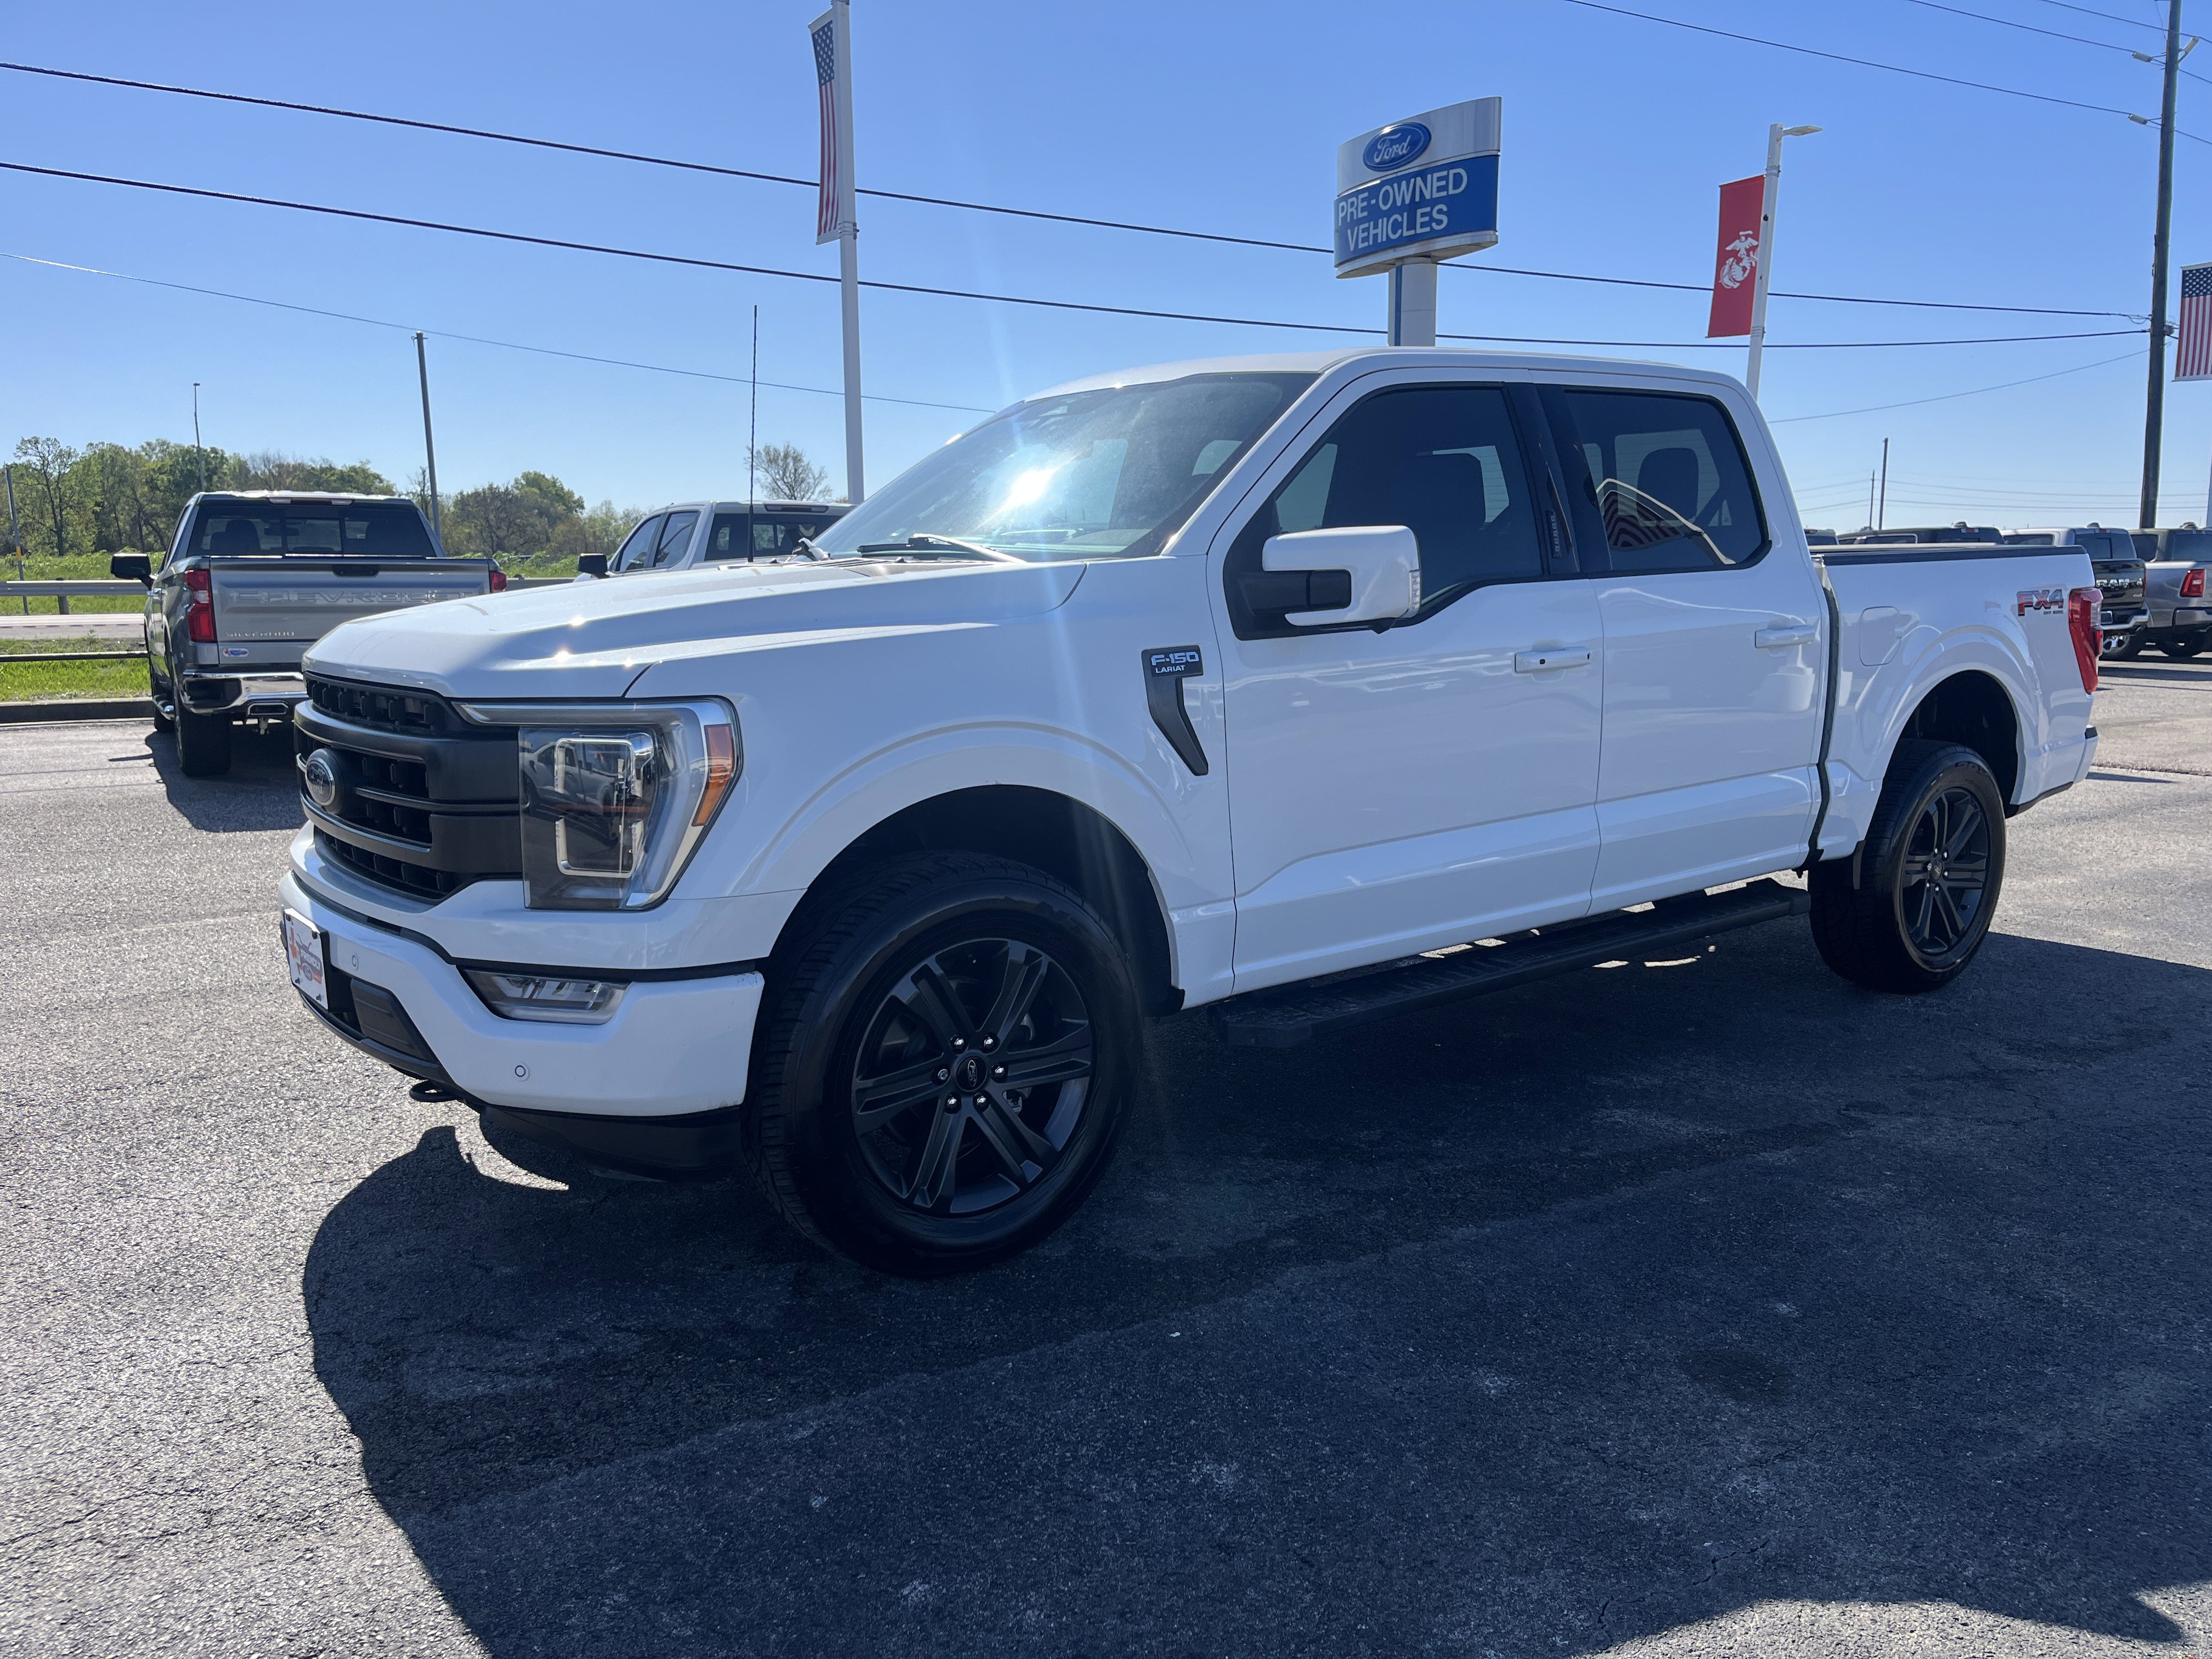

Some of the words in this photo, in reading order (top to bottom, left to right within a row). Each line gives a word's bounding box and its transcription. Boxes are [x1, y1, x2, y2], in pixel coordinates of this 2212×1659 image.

[1374, 133, 1411, 163] Ford
[1338, 167, 1468, 226] PRE-OWNED
[1347, 204, 1448, 251] VEHICLES
[2016, 589, 2064, 617] FX4
[1151, 651, 1199, 665] F-150
[1155, 664, 1186, 674] LARIAT
